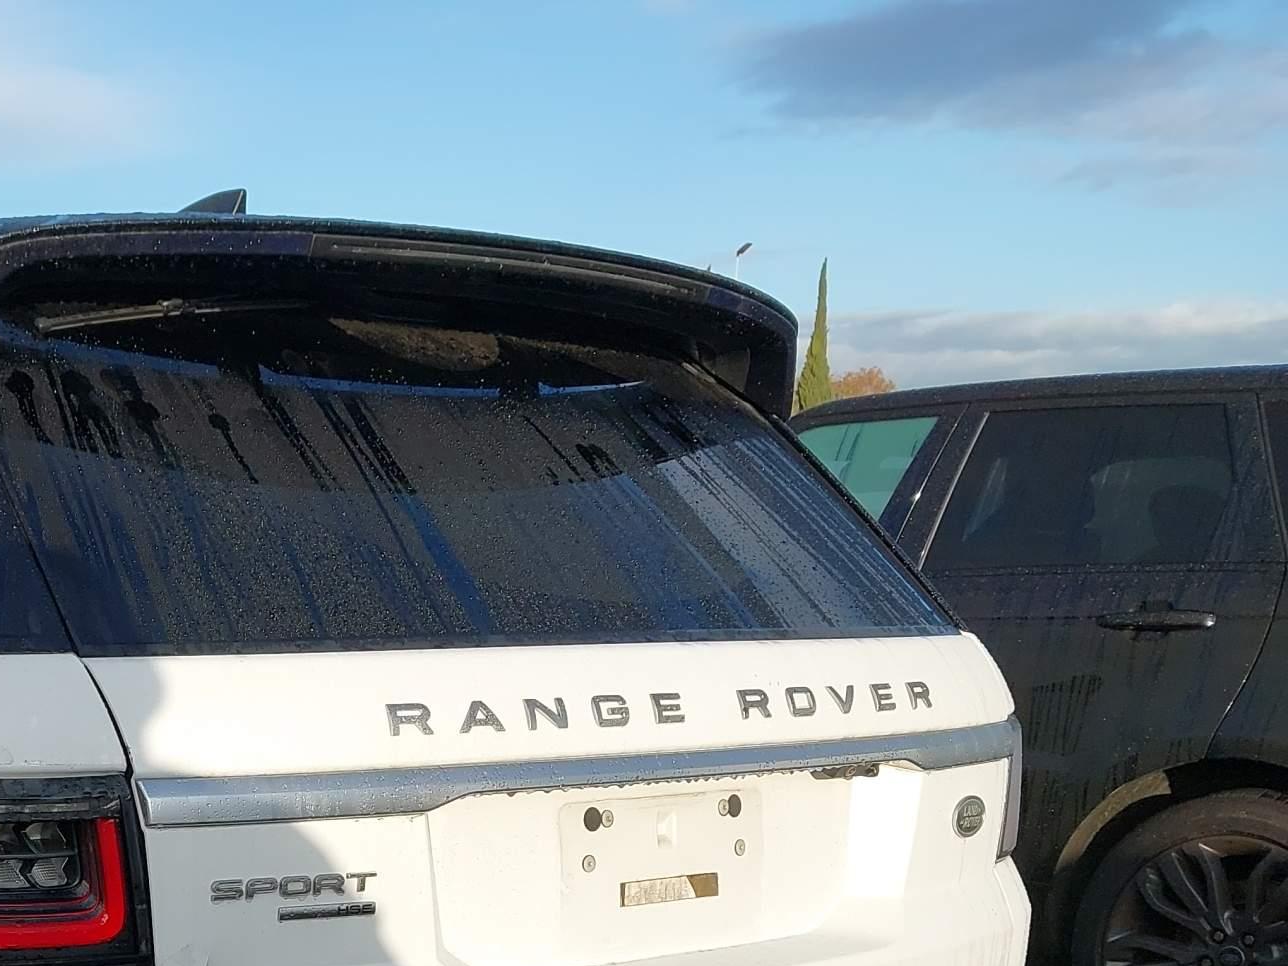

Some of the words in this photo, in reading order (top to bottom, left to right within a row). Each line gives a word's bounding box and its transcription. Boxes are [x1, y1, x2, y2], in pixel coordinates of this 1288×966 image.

[386, 692, 685, 736] RANGE
[736, 680, 934, 721] ROVER
[210, 872, 378, 902] SPORT
[337, 903, 373, 916] HSE
